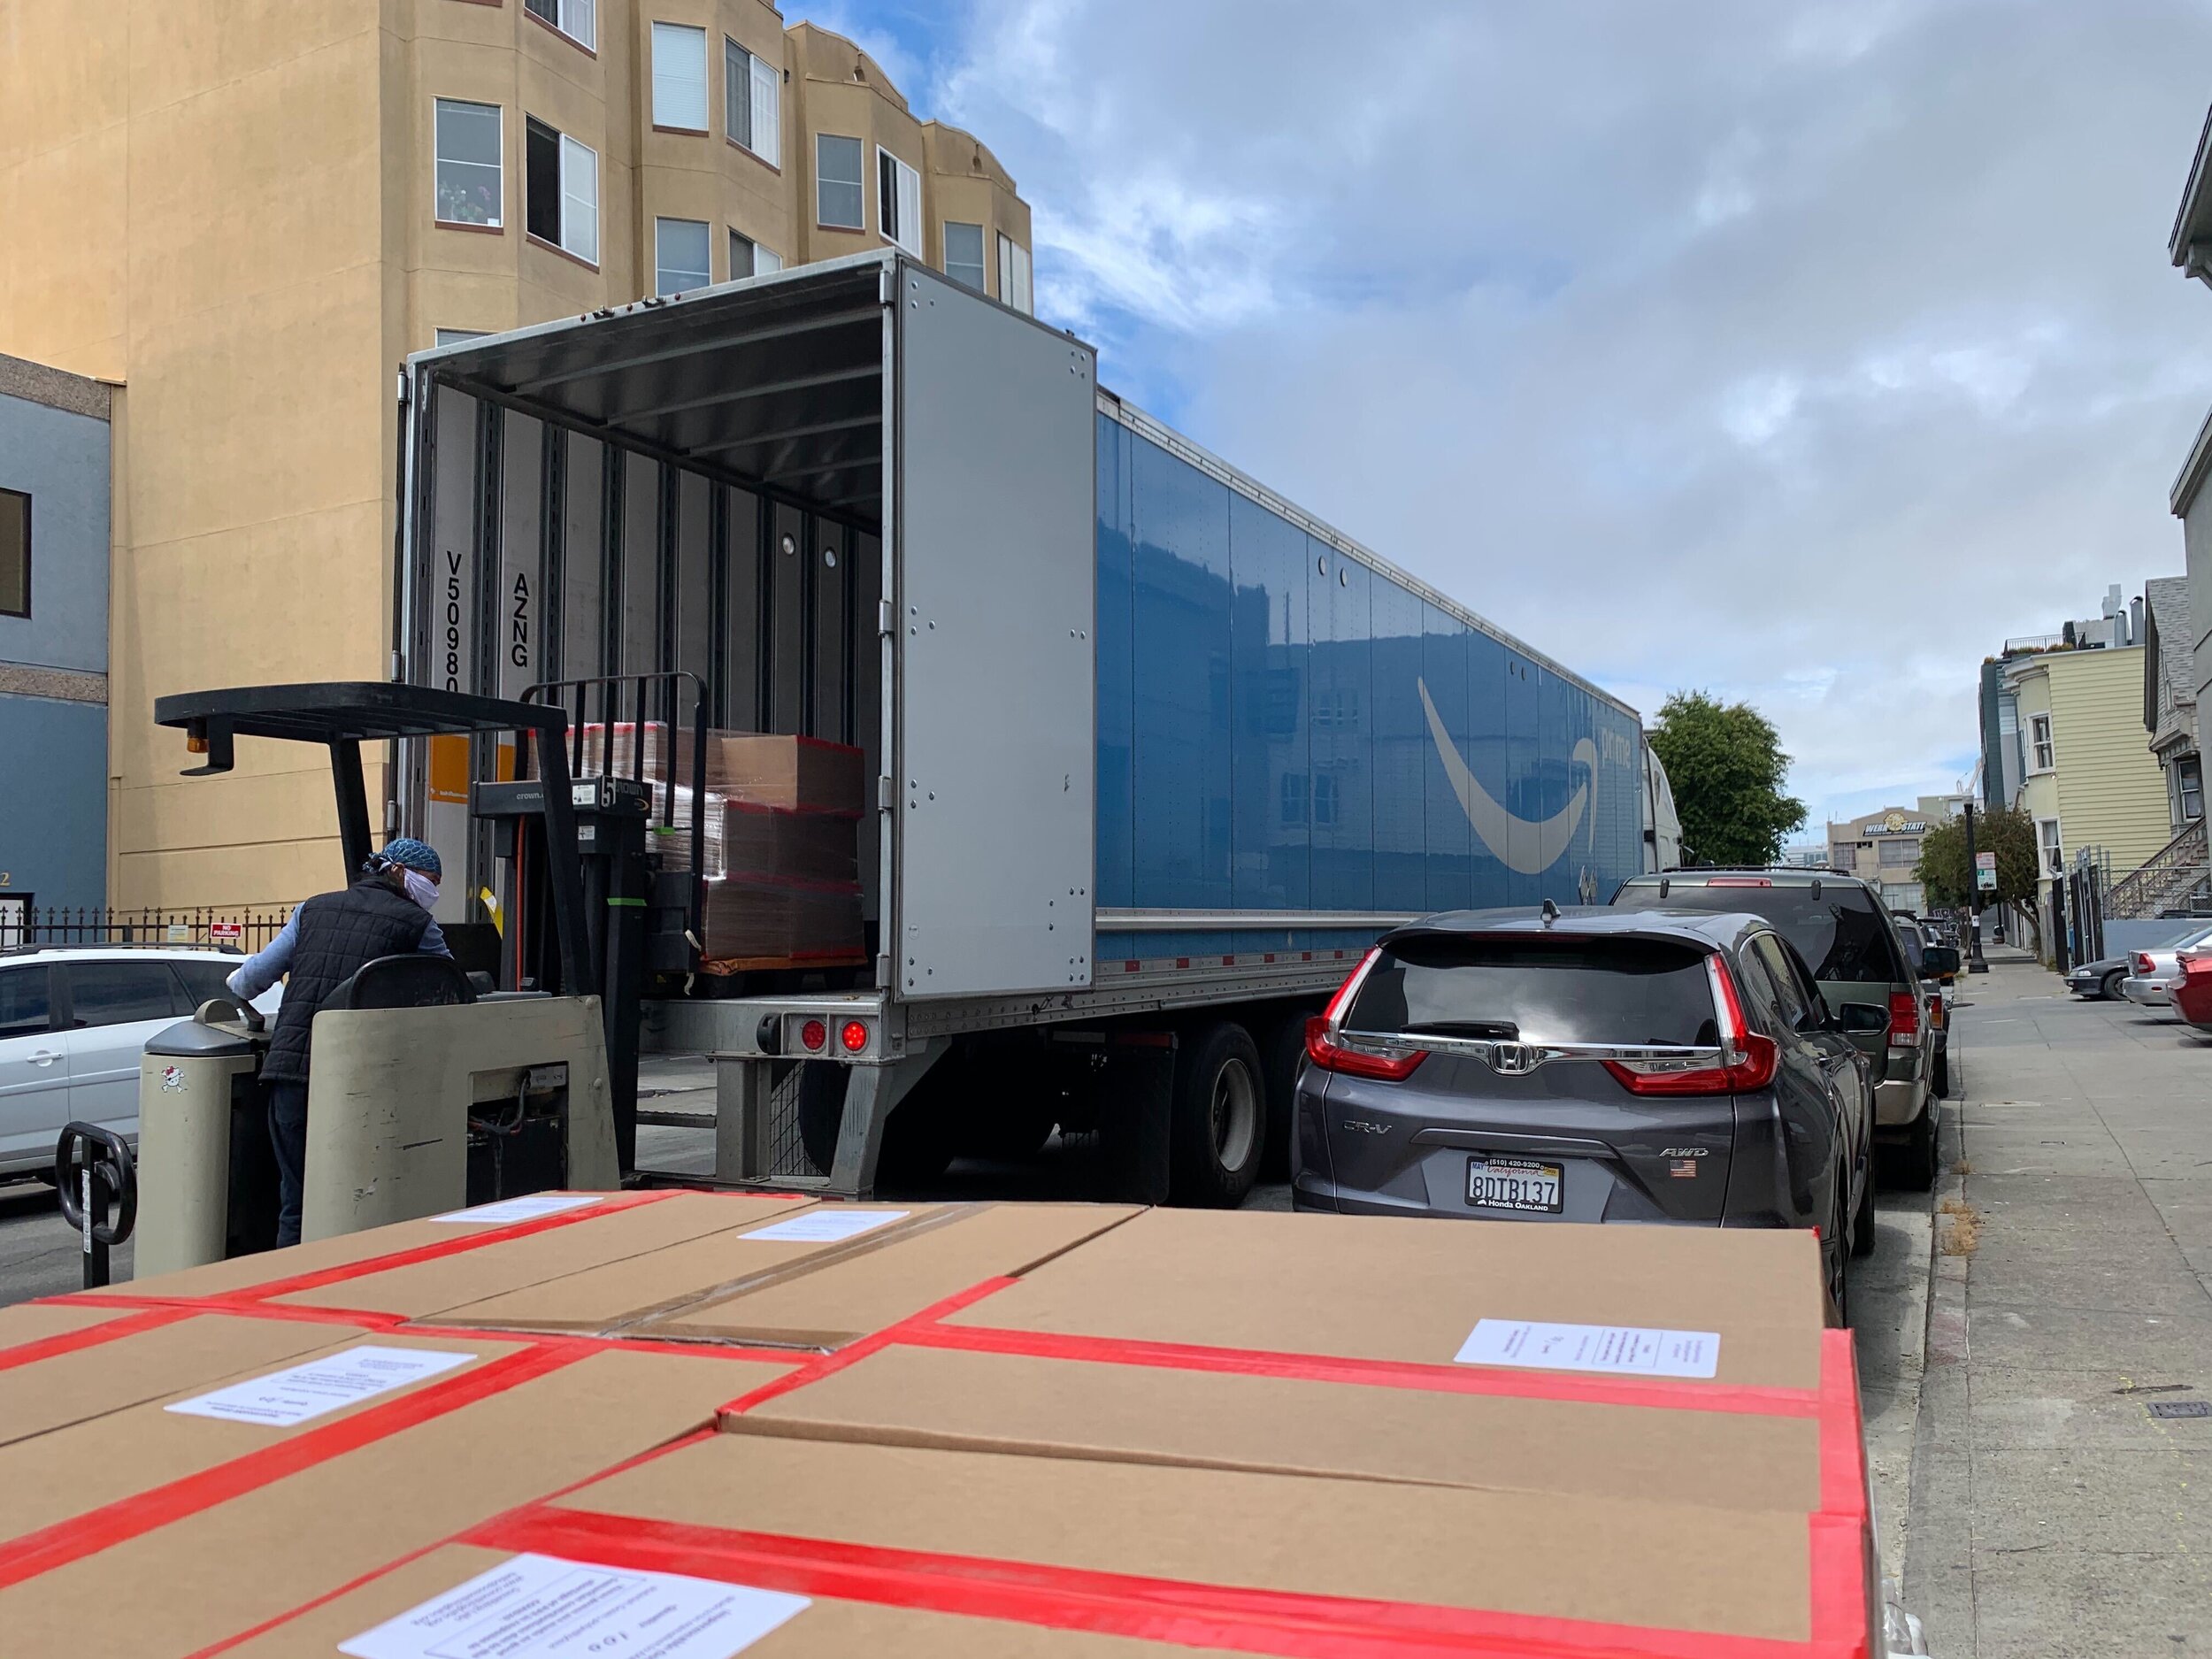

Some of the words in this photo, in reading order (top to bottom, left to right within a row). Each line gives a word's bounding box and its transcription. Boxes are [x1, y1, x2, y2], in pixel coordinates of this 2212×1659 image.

[511, 572, 529, 668] AZNG
[1342, 1120, 1393, 1135] CR-V
[1659, 1148, 1709, 1158] AWD
[1489, 1158, 1507, 1167] (510)
[1508, 1160, 1540, 1169] 420-9200
[1487, 1165, 1545, 1178] California
[1472, 1176, 1555, 1204] 8DTB137
[1488, 1199, 1514, 1209] Honda
